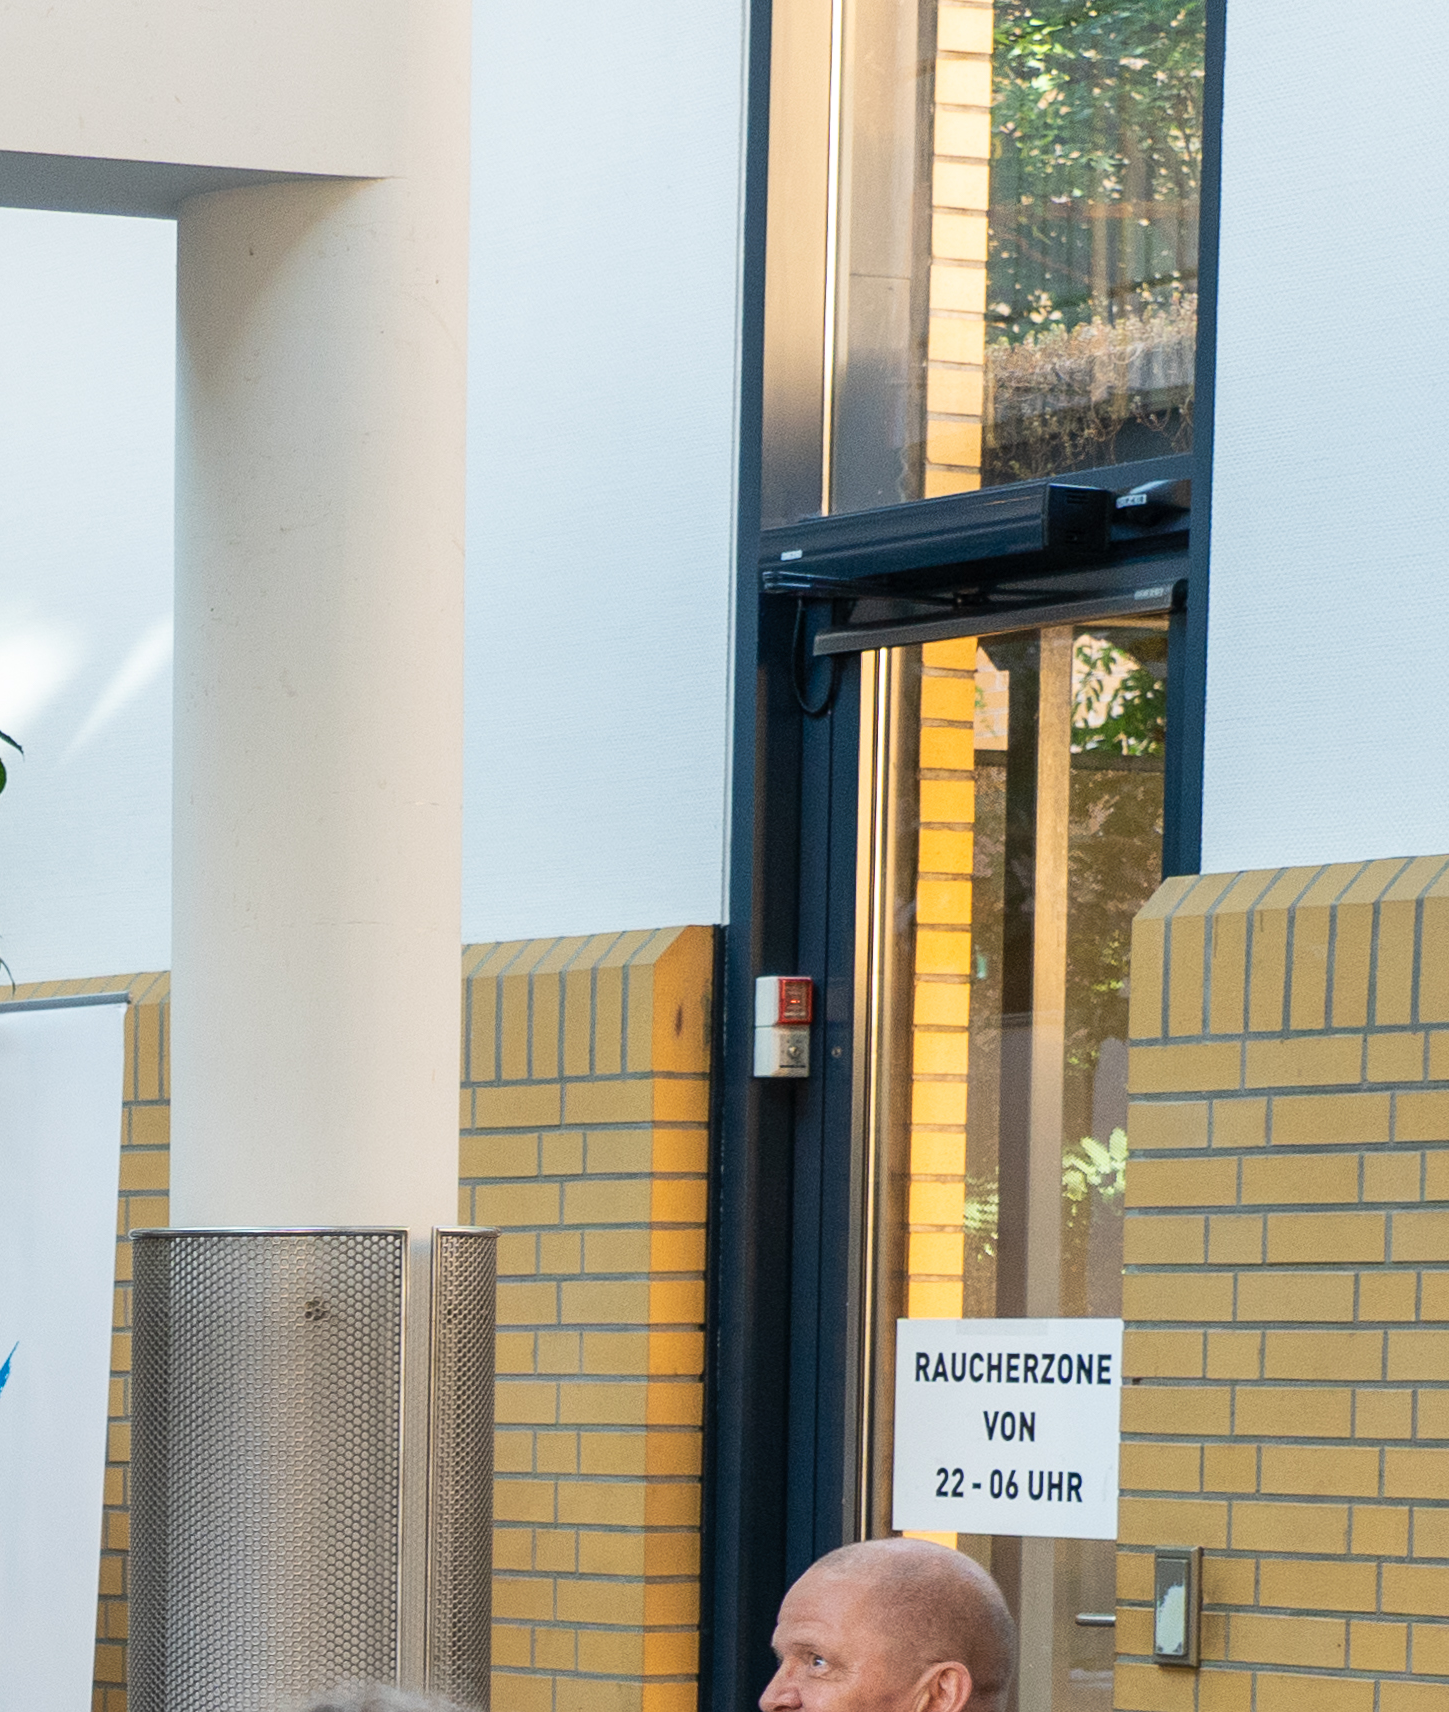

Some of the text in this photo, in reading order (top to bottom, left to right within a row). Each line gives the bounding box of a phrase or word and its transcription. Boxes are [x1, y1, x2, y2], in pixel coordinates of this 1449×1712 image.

[914, 1352, 1112, 1385] RAUCHERZONE
[983, 1411, 1036, 1442] VON
[935, 1467, 965, 1498] 22
[989, 1469, 1019, 1500] 06
[1028, 1470, 1083, 1502] UHR
